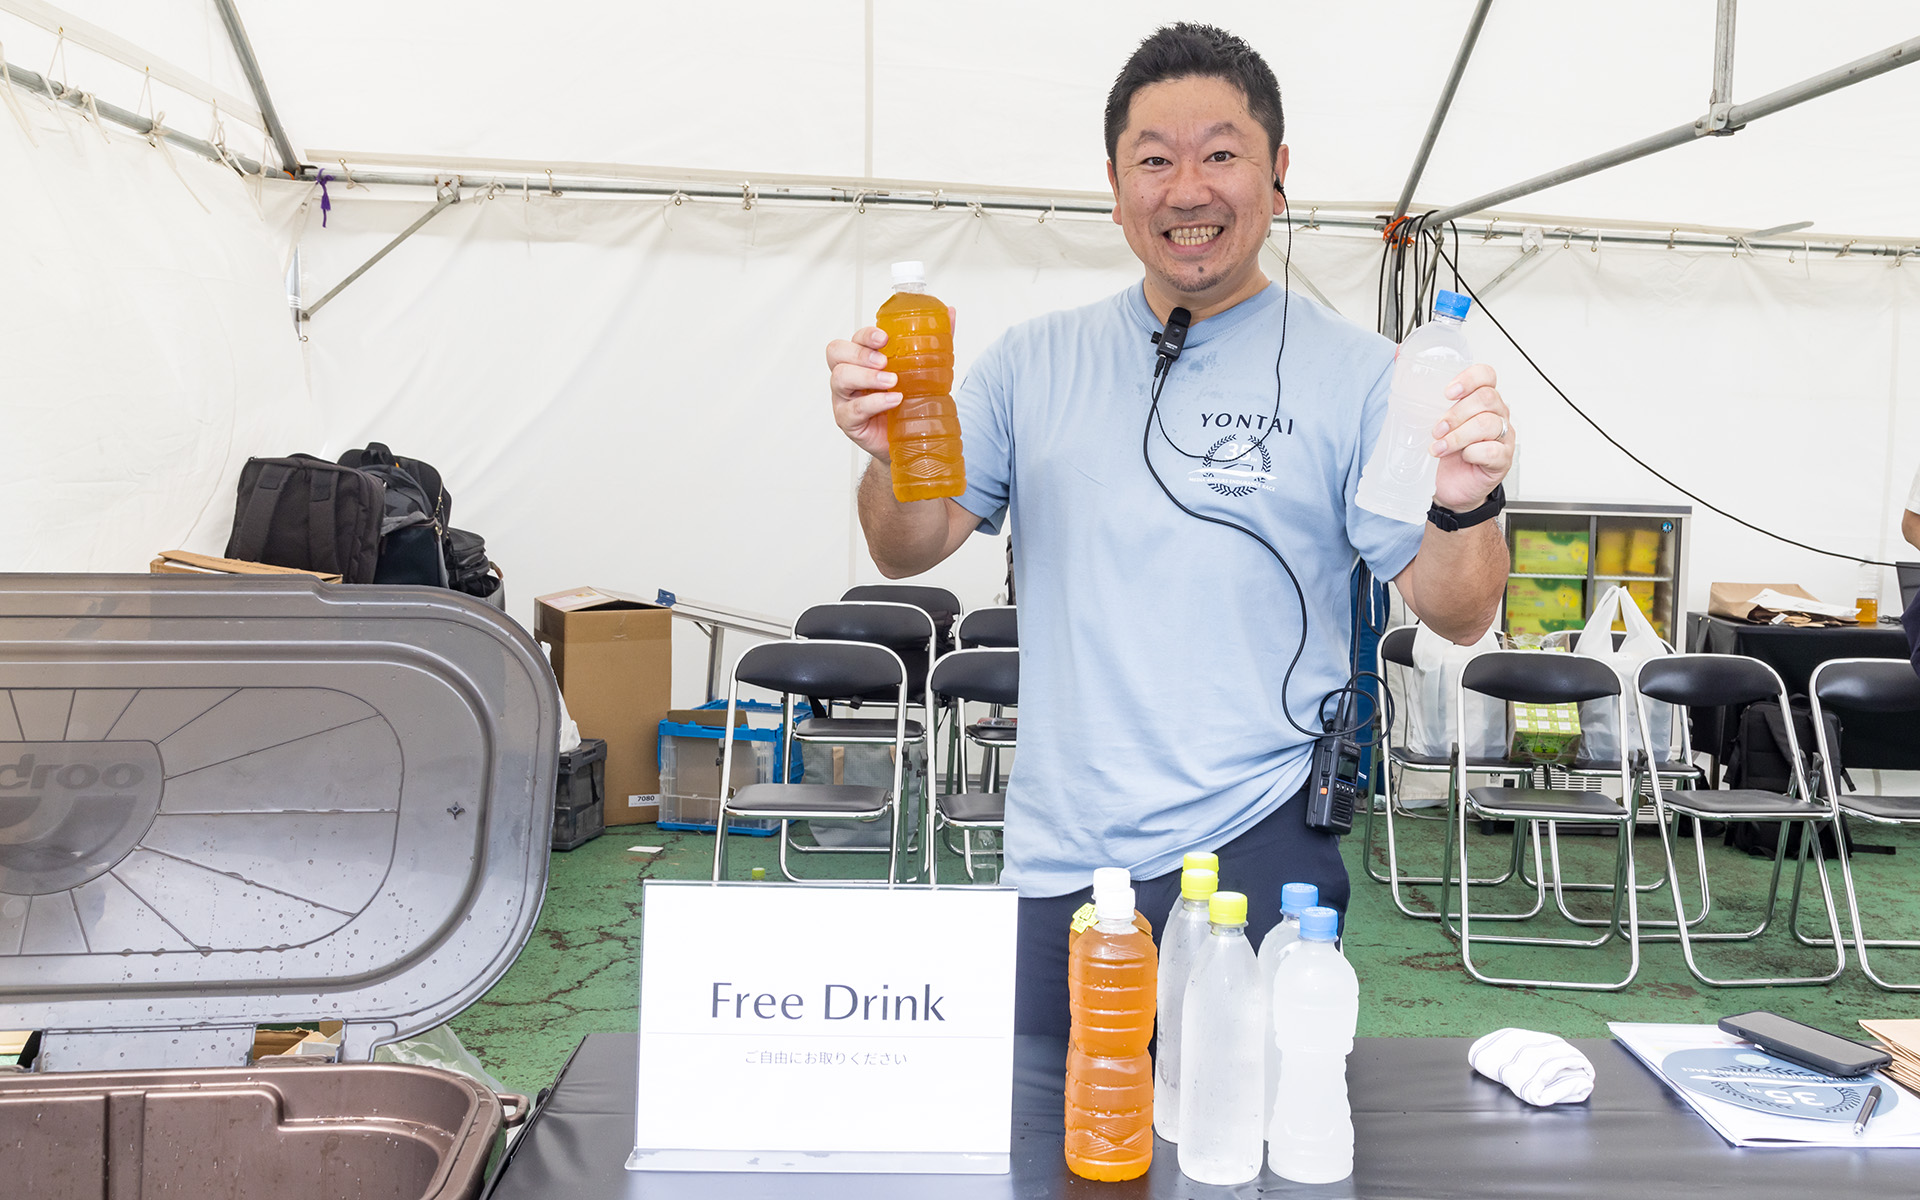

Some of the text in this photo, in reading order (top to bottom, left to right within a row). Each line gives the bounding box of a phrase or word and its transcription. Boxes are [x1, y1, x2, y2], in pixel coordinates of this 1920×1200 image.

[1201, 413, 1293, 435] YONTAI
[712, 982, 946, 1021] Free Drink
[745, 1050, 908, 1066] ご自由にお取りください
